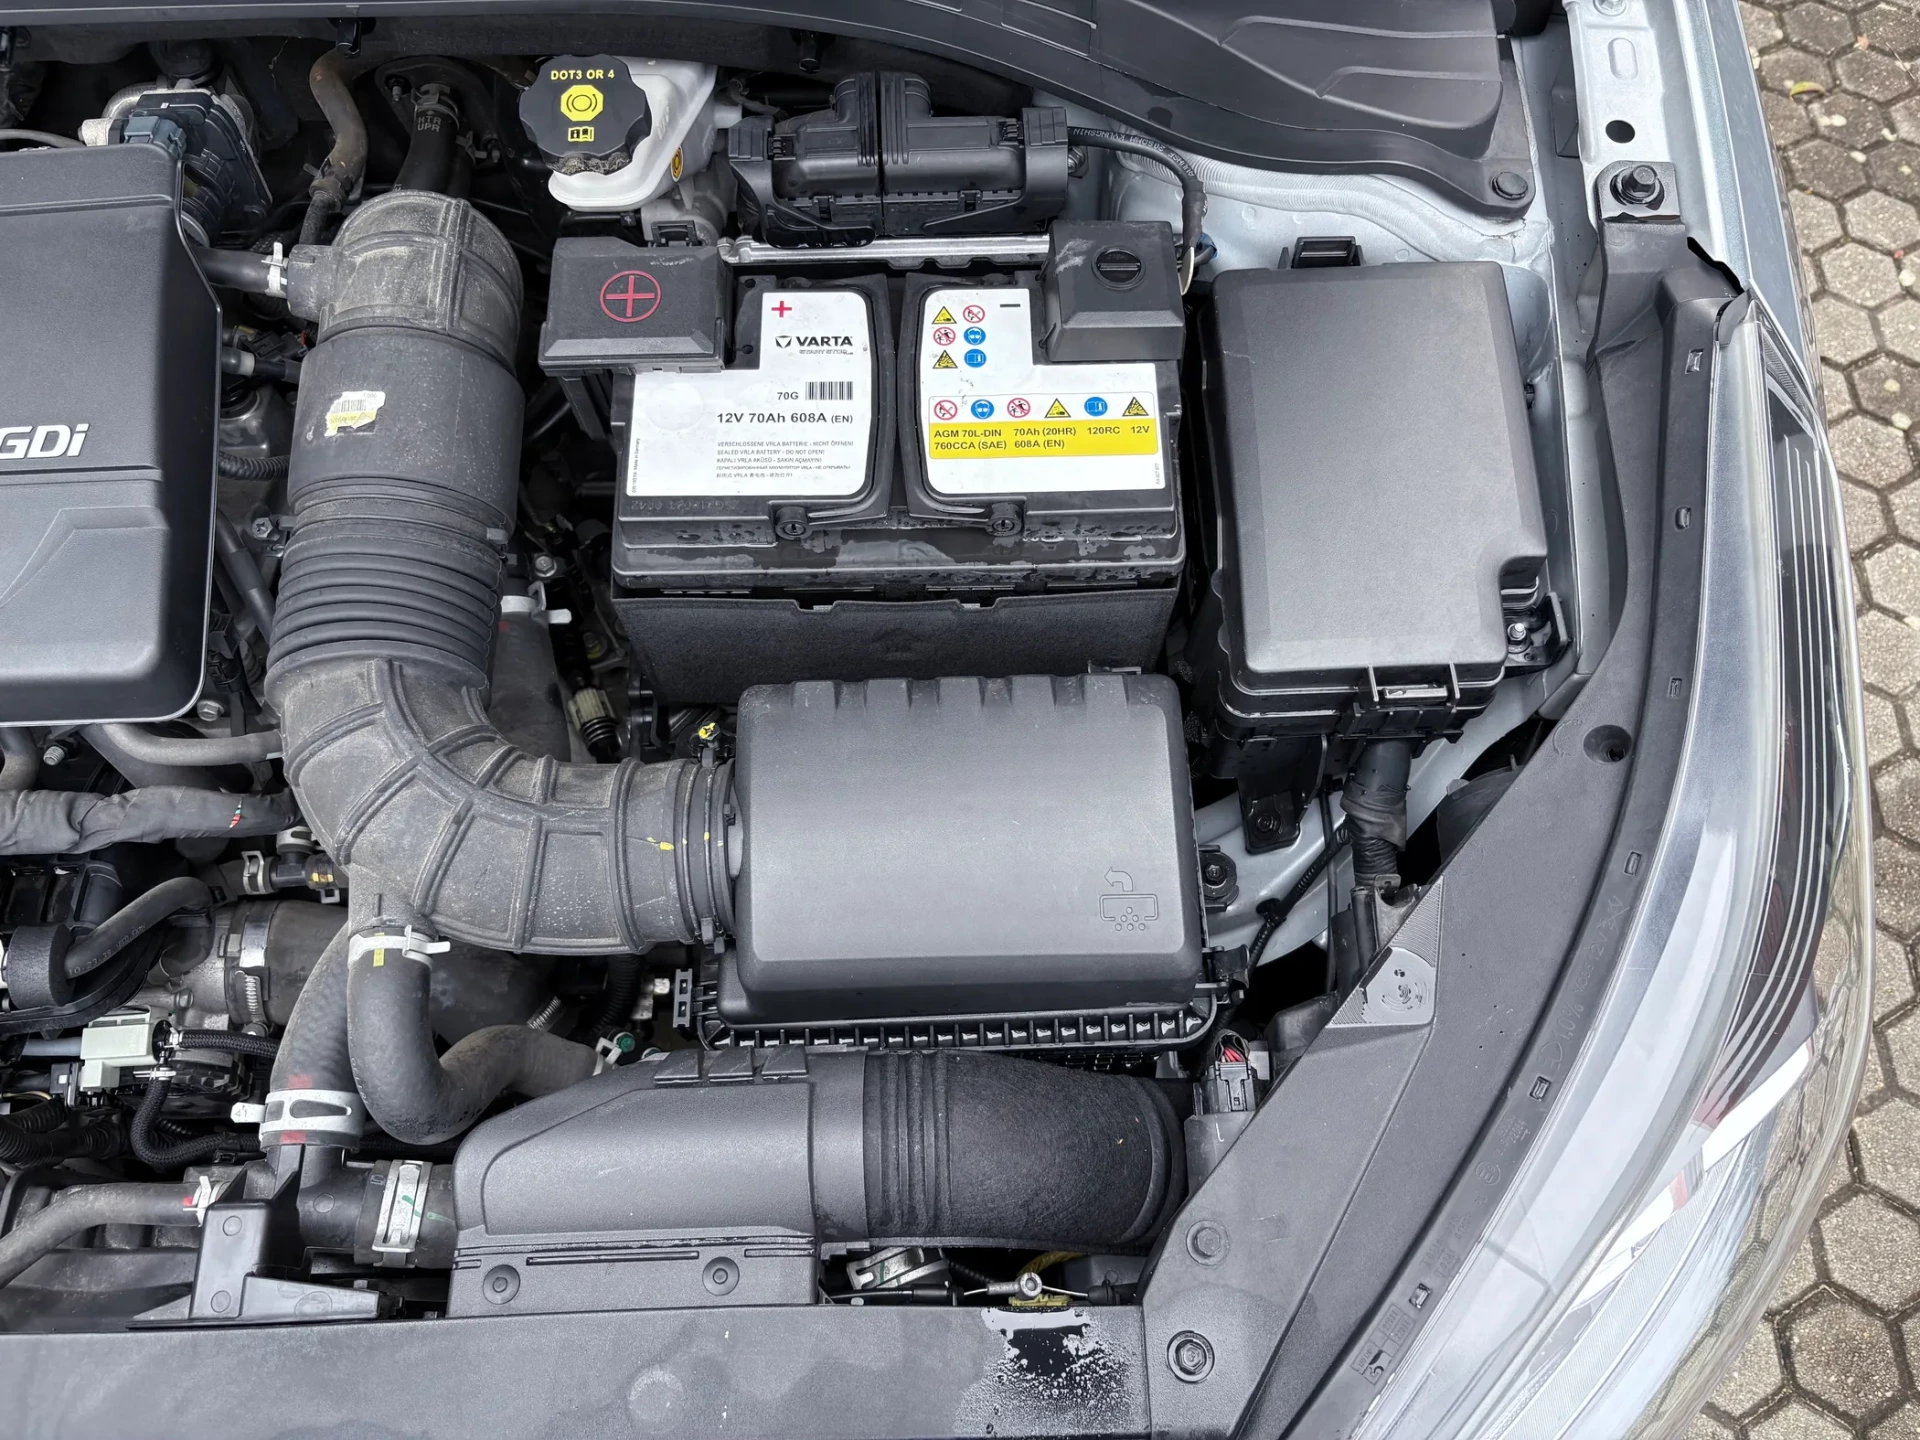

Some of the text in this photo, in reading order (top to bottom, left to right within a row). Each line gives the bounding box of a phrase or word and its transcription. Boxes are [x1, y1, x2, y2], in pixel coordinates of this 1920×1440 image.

[550, 69, 615, 80] DOT3 OR 4
[418, 116, 442, 125] HTR
[418, 122, 440, 132] UPR
[796, 336, 853, 346] VARTA
[777, 392, 799, 400] 70G
[717, 413, 853, 424] 12V 70Ah 608A (EN)
[934, 426, 1150, 438] AGM 70L-DIN 70Ah (20HR) 120RC 12V
[0, 423, 89, 460] GDi
[934, 440, 1065, 450] 760CCA (SAE) 608A (EN)
